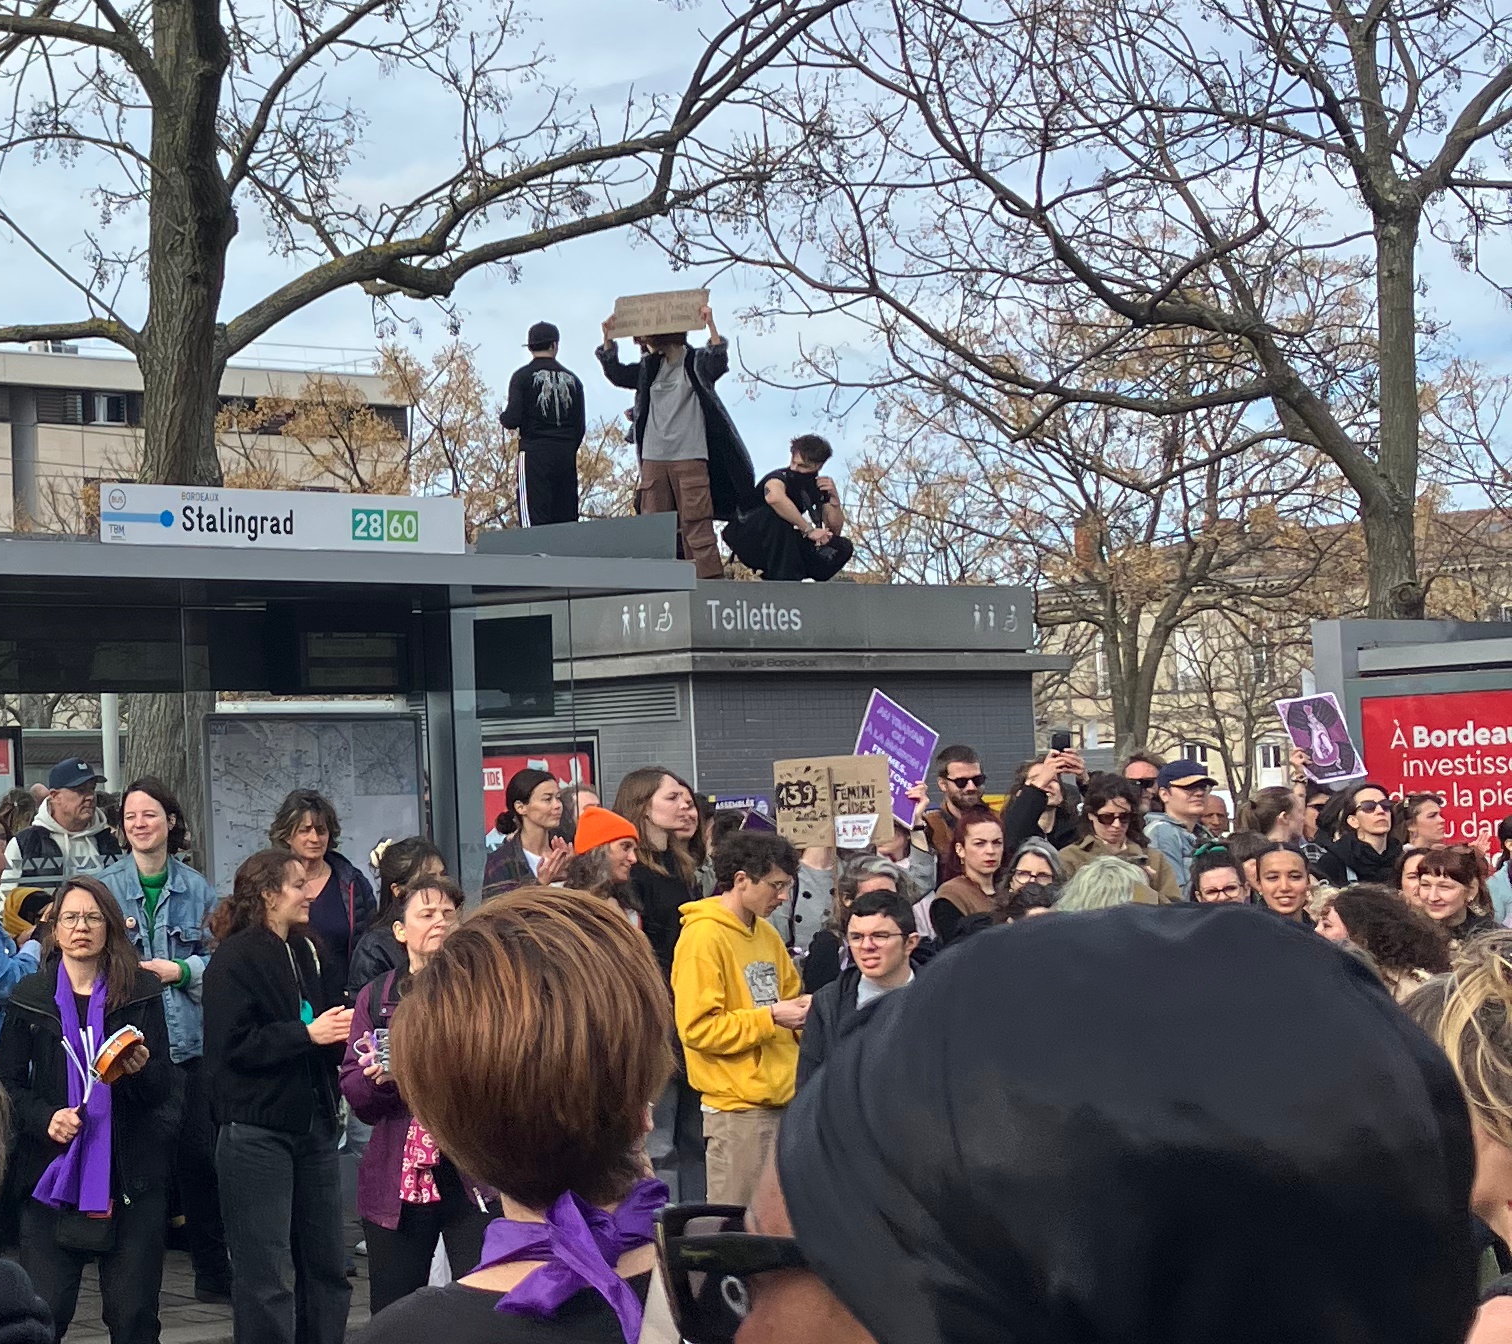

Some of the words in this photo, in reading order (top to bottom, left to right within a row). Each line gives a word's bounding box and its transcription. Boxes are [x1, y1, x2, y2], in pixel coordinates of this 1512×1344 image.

[181, 492, 220, 503] BORDEAUX
[182, 506, 294, 541] Stalingrad
[354, 512, 383, 538] 28
[389, 513, 417, 539] 60
[706, 599, 802, 631] Toilettes
[1390, 719, 1409, 750] À
[1403, 751, 1512, 778] investiss
[1389, 782, 1448, 808] ds
[1453, 781, 1473, 807] la
